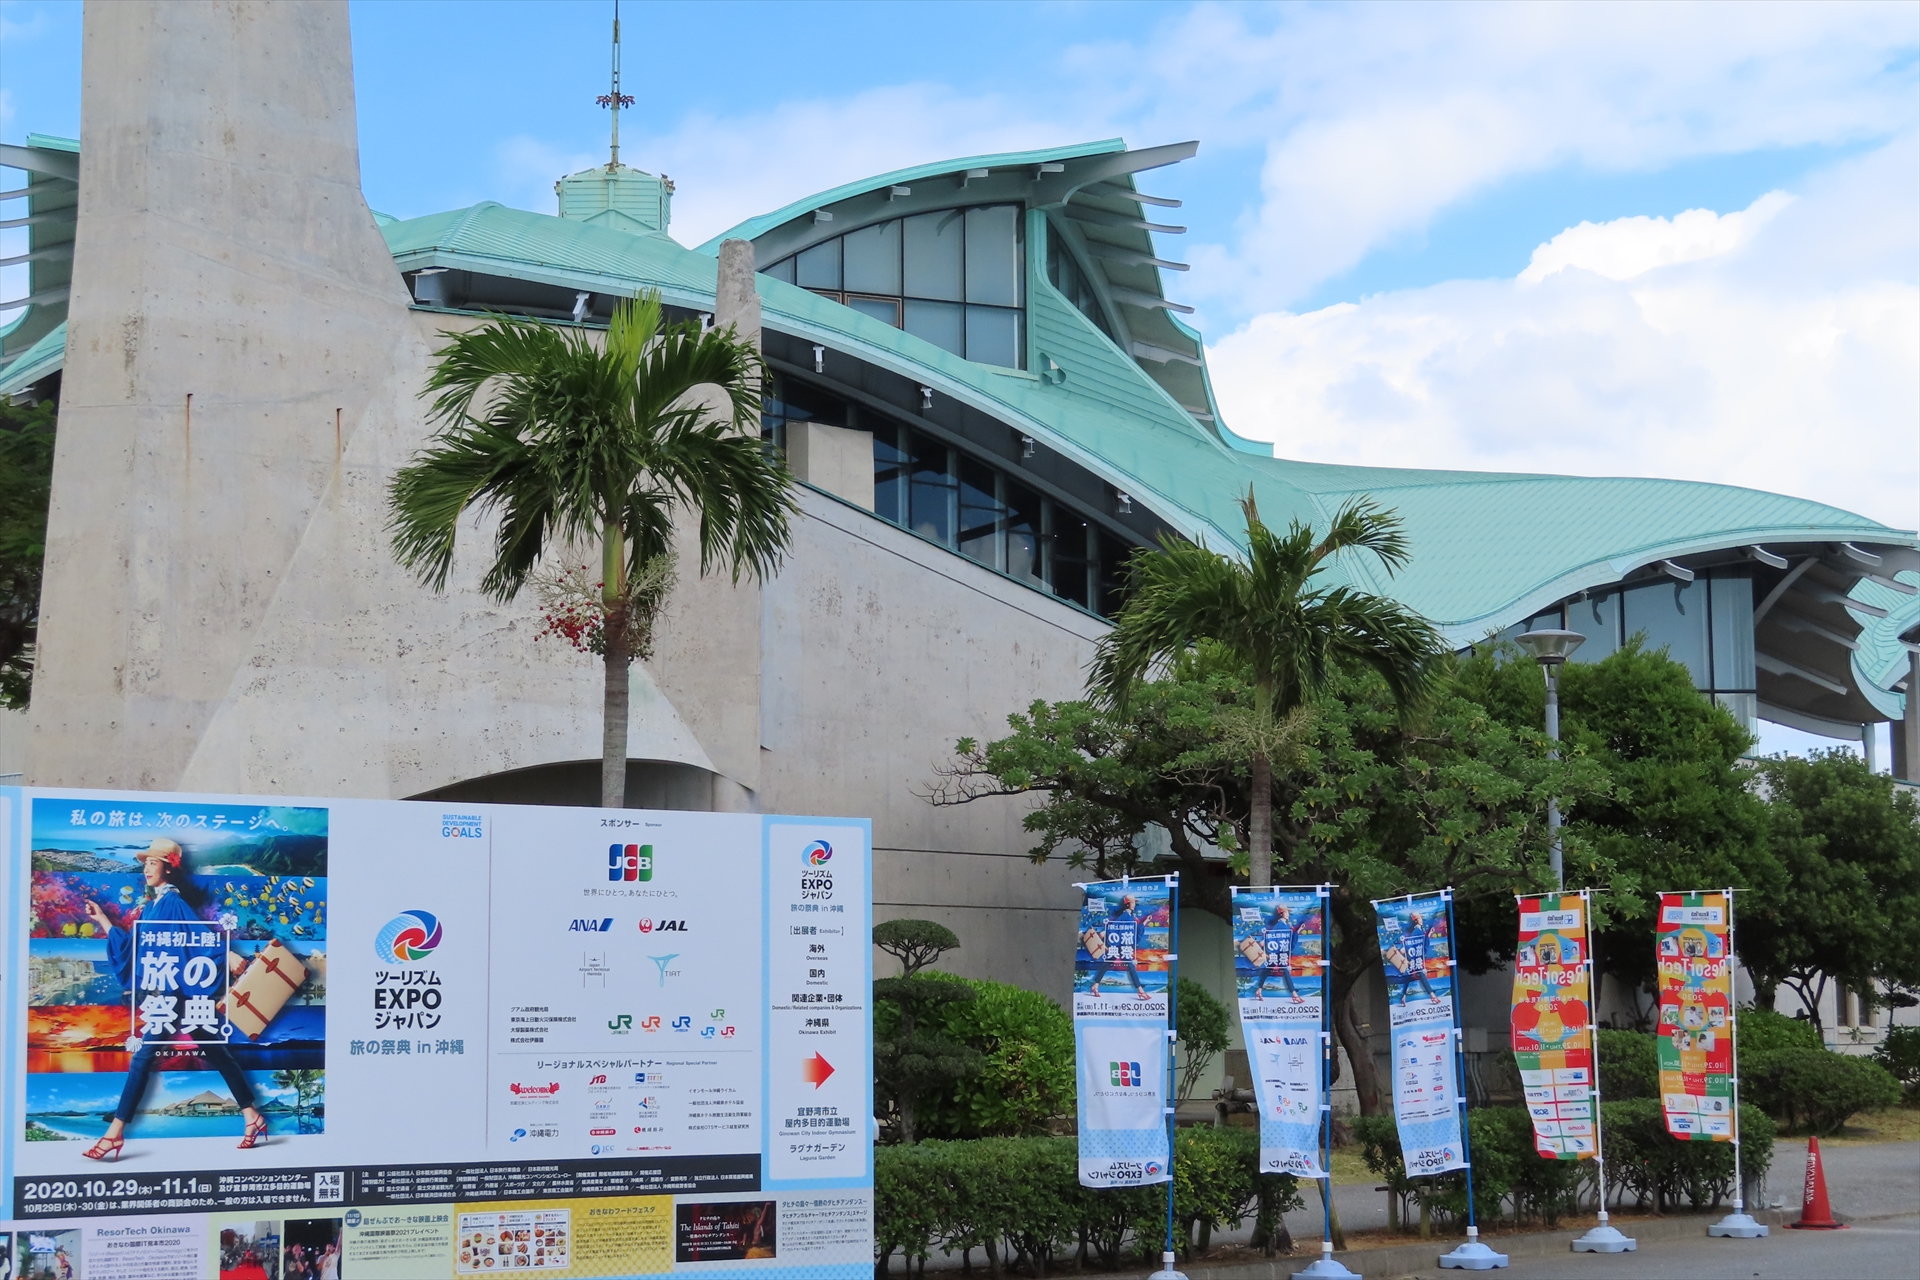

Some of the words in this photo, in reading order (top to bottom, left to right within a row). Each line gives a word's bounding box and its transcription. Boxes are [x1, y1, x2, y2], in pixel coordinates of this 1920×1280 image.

[70, 808, 291, 832] 私の旅は、次のステージへ。
[600, 819, 639, 828] スポンサー
[442, 827, 482, 838] GOALS
[801, 870, 833, 878] ツーリズム
[802, 879, 833, 890] EXPO
[583, 888, 678, 898] 世界にひとつ。あなたにひとつ。
[802, 891, 833, 900] ジャパン
[790, 904, 819, 912] 旅の祭典
[830, 904, 844, 913] 沖縄
[568, 918, 599, 932] ANA
[655, 920, 689, 932] JAL
[140, 930, 222, 948] 沖縄初上陸!
[808, 944, 825, 954] 海外
[140, 951, 218, 991] 旅の
[809, 969, 826, 978] 国内
[375, 970, 442, 986] ツーリズム
[374, 988, 442, 1010] EXPO
[792, 994, 843, 1003] 関連企業・団体
[710, 1008, 725, 1018] JR
[374, 1012, 442, 1030] ジャパン
[608, 1015, 632, 1030] JR
[642, 1016, 661, 1028] JR
[672, 1016, 691, 1028] JR
[805, 1018, 830, 1028] 沖縄県
[700, 1026, 715, 1036] JR
[720, 1026, 735, 1036] JR
[350, 1040, 411, 1055] 旅の祭典
[417, 1041, 431, 1054] in
[435, 1039, 465, 1055] 沖縄
[537, 1059, 663, 1070] リージョナルスペシャルパートナー
[589, 1074, 607, 1085] JTB
[520, 1083, 550, 1094] welcome
[797, 1107, 838, 1116] 宜野湾市立
[785, 1118, 850, 1128] 屋内多目的運動場
[529, 1129, 559, 1138] 沖縄電力
[790, 1144, 846, 1153] ラグナガーデン
[219, 1174, 308, 1184] 沖縄コンベンションセンター
[318, 1176, 341, 1187] 入場
[24, 1177, 212, 1200] 2020.10.29(木)-11.1(日)
[218, 1182, 312, 1192] 及び宜野湾市立多目的運動場
[318, 1187, 341, 1200] 無料
[589, 1206, 656, 1216] おきなわフードフェスタ
[97, 1228, 148, 1237] ResorTech
[150, 1226, 192, 1235] Okinawa
[680, 1224, 692, 1233] The
[693, 1223, 713, 1232] Islands
[714, 1223, 721, 1232] of
[722, 1222, 740, 1232] Tahiti
